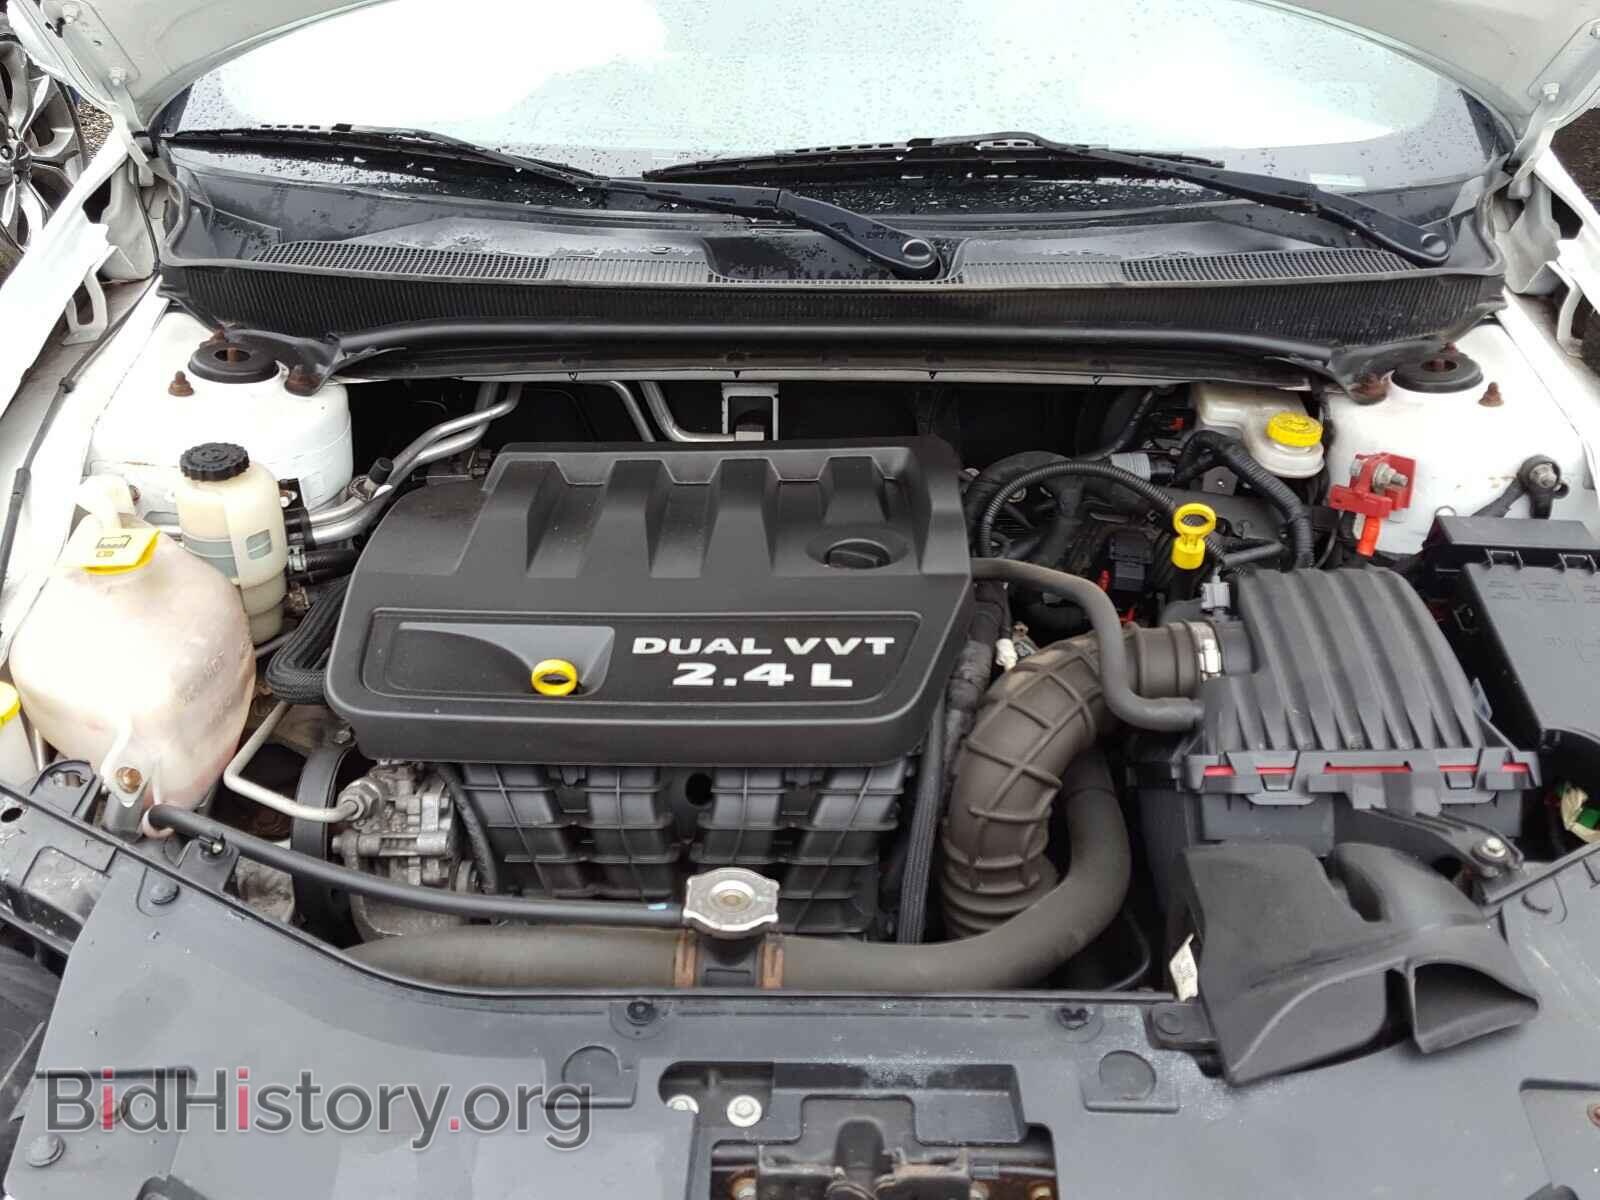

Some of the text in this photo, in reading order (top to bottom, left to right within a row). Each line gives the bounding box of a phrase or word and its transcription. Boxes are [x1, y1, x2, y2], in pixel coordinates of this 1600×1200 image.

[632, 637, 895, 655] DUAL VVT
[672, 662, 853, 687] 2.4 L
